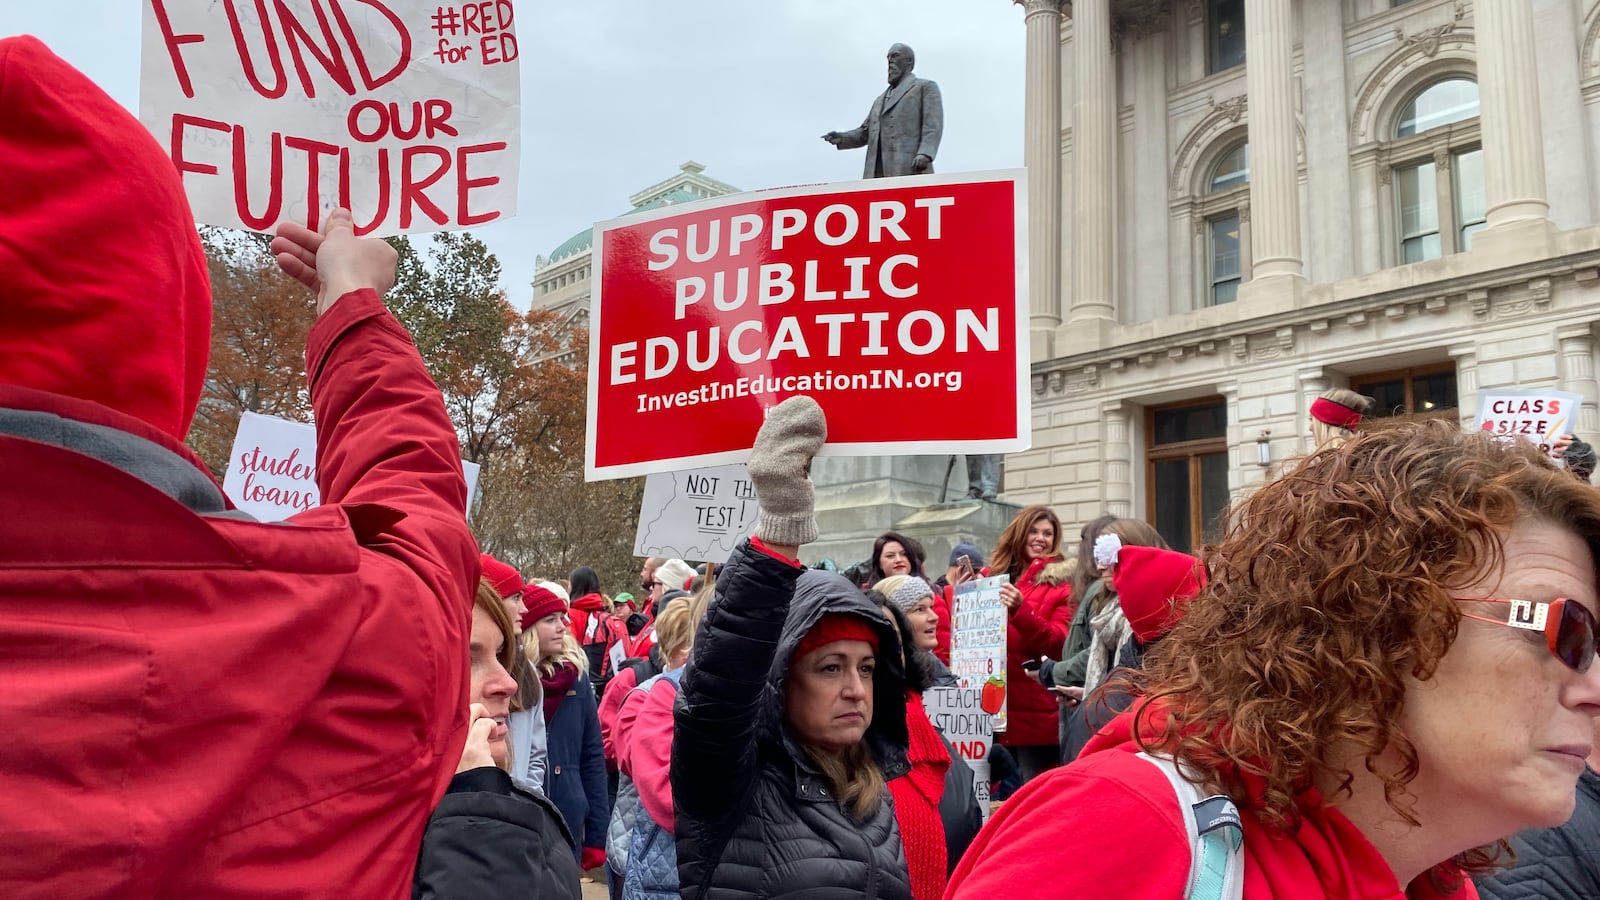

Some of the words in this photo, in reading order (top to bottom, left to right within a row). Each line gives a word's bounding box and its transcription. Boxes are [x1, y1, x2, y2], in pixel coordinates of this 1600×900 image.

[431, 0, 514, 36] #RED
[151, 0, 412, 98] FUND
[433, 38, 473, 64] for
[480, 32, 519, 65] ED
[347, 99, 459, 142] OUR
[171, 113, 507, 236] FUTURE
[648, 197, 955, 272] SUPPORT
[675, 254, 918, 320] PUBLIC
[611, 307, 1000, 385] EDUCATION
[636, 370, 962, 413] InvestInEducationIN.org
[1492, 400, 1561, 415] CLASS
[1497, 420, 1548, 434] SIZE
[239, 446, 316, 481] studen
[243, 473, 316, 513] loans
[686, 474, 720, 496] NOT
[734, 480, 757, 498] TH
[695, 500, 745, 529] TEST!
[934, 688, 981, 709] TEACH
[936, 714, 993, 736] STUDENTS
